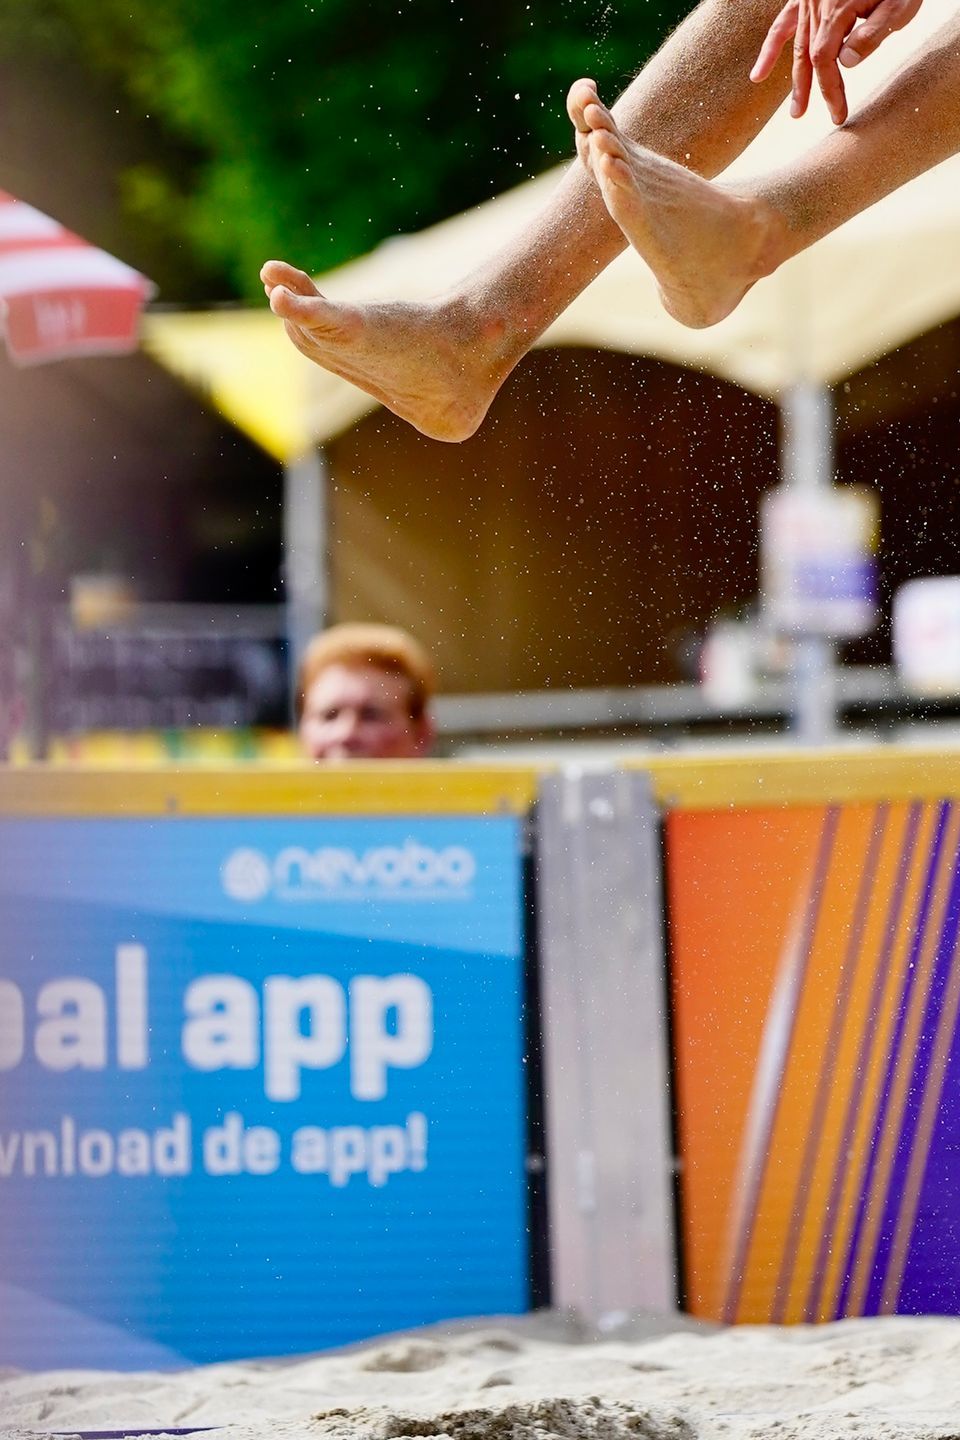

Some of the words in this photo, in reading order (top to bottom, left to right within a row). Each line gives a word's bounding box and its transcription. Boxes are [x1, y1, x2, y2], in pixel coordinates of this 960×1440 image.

[181, 973, 434, 1102] app
[203, 1111, 281, 1177] de
[290, 1111, 428, 1187] app!
